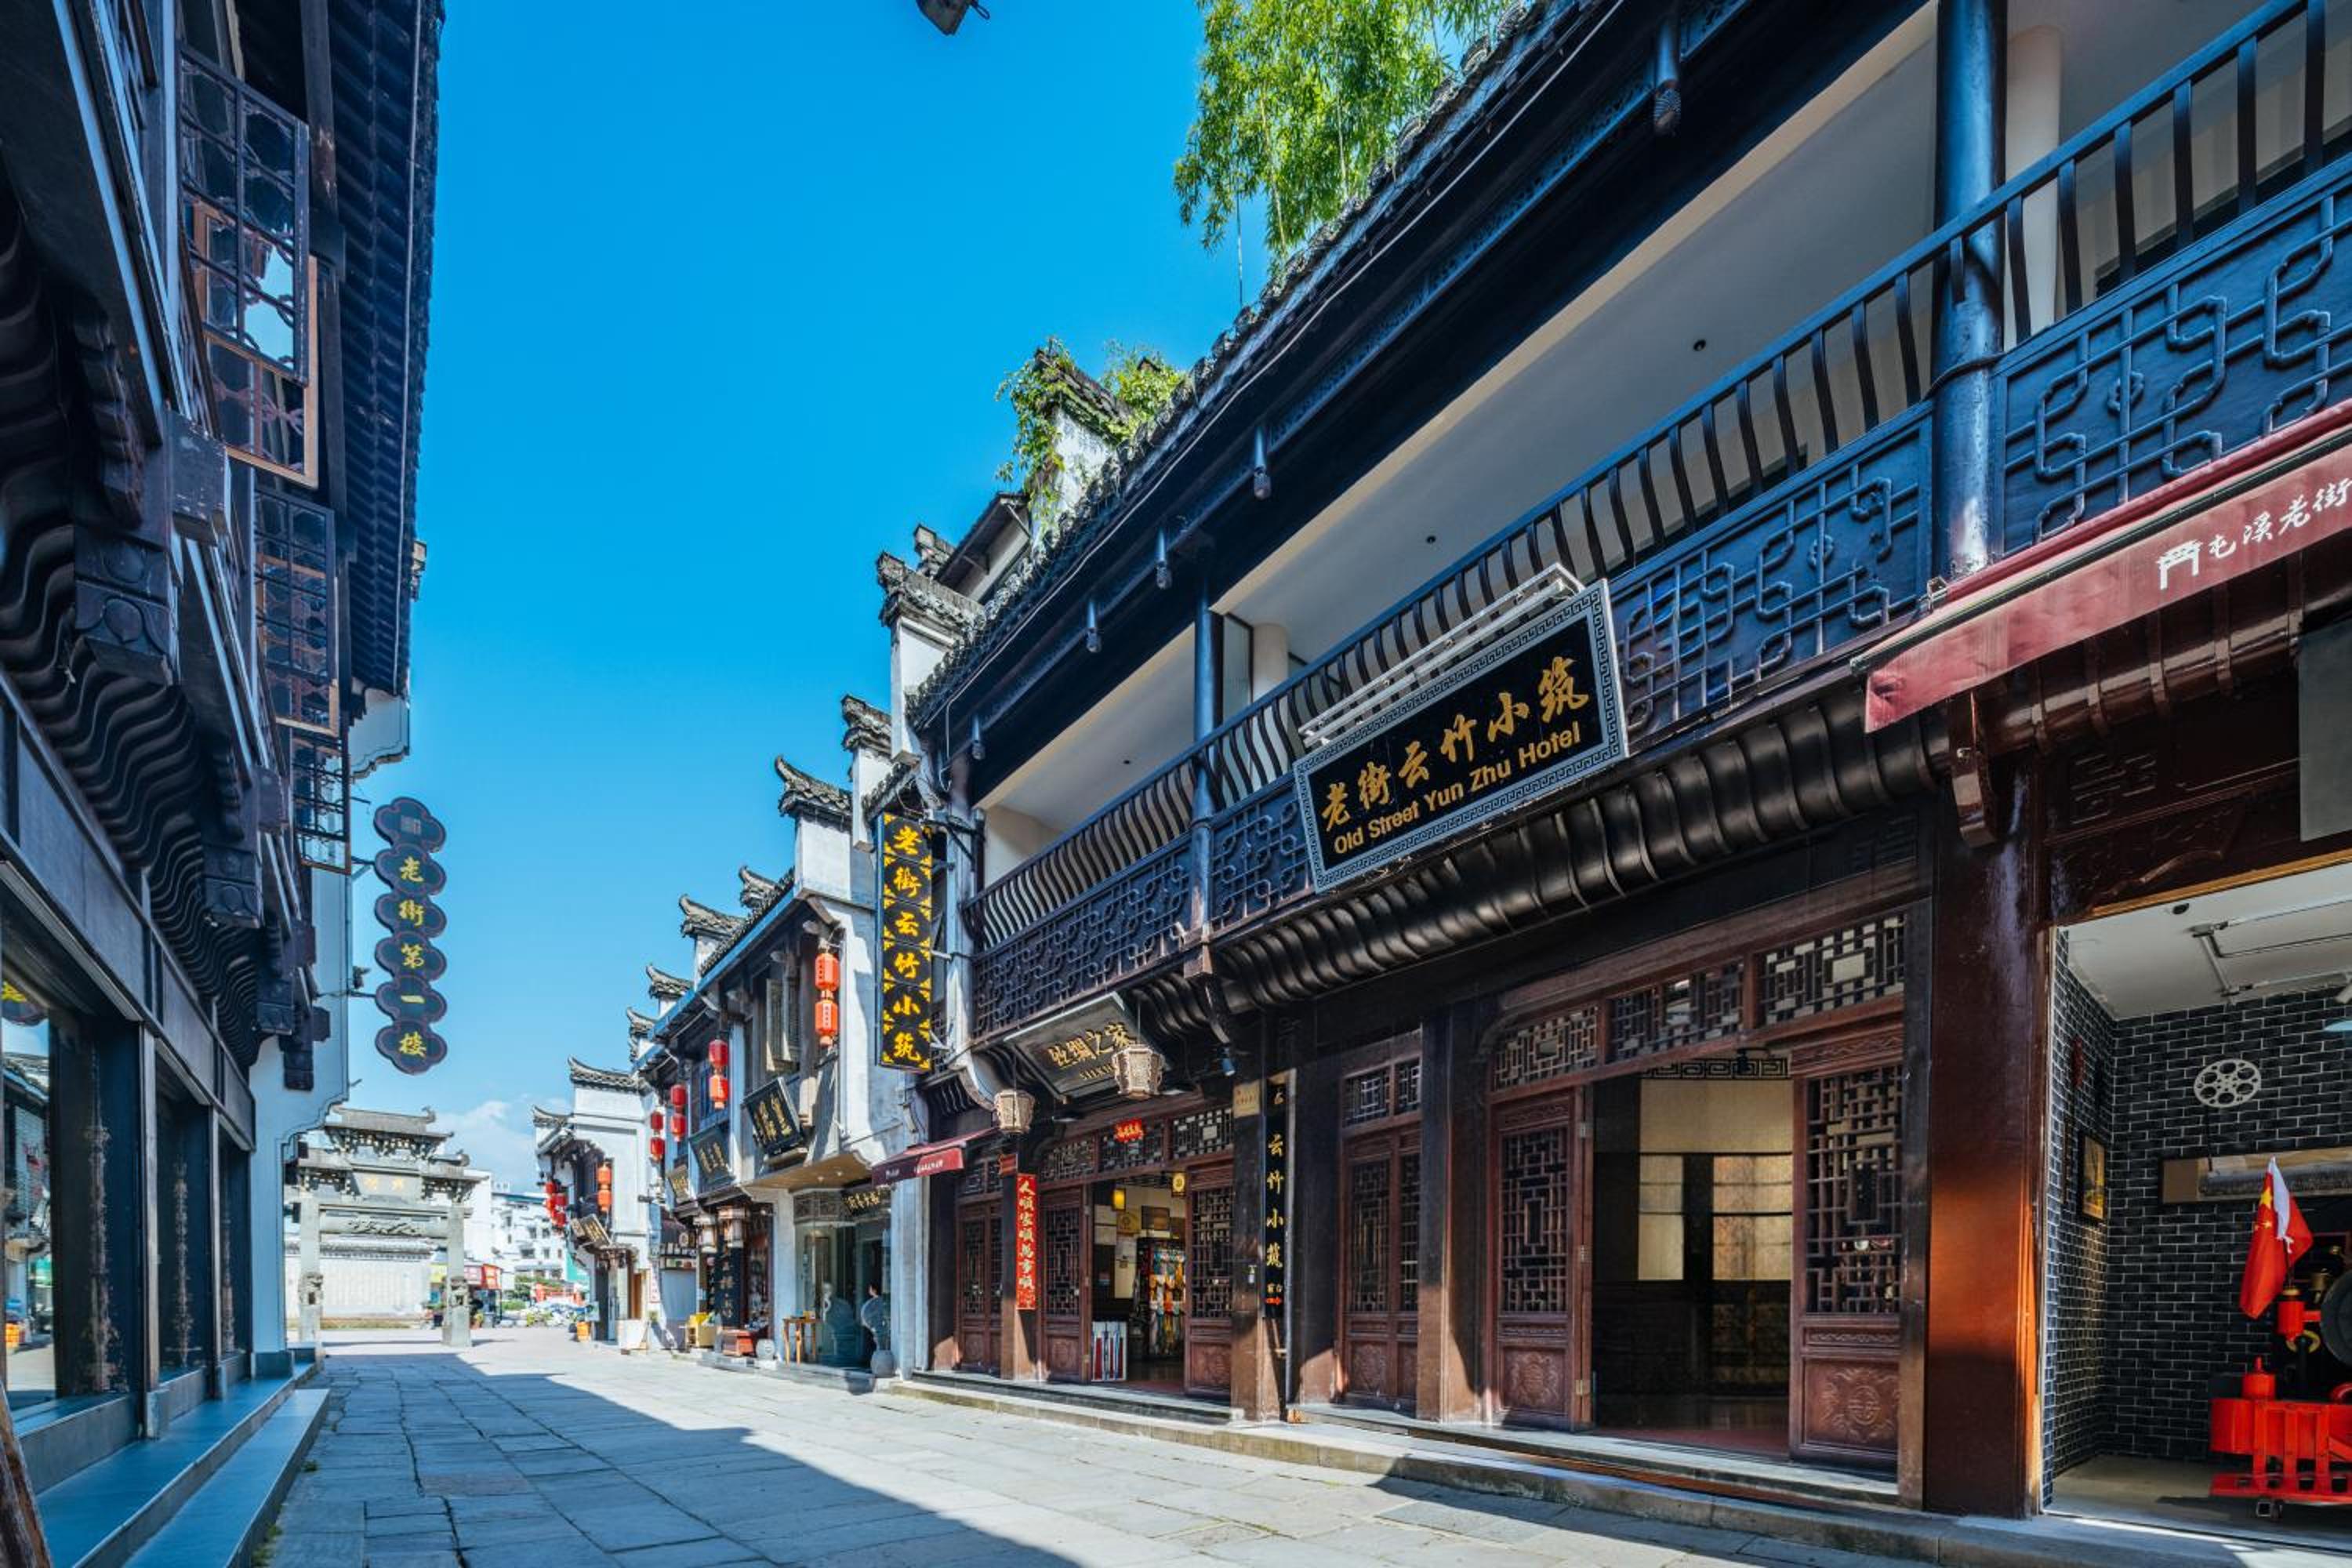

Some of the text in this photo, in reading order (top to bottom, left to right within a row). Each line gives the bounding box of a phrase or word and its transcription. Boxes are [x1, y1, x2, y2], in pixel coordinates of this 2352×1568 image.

[2209, 477, 2352, 543] 屯溪老街
[1321, 656, 1589, 832] 老街云竹小筑
[1334, 720, 1581, 854] Old Street Yun Zhu Hotel
[893, 826, 922, 1061] 老街云竹小筑
